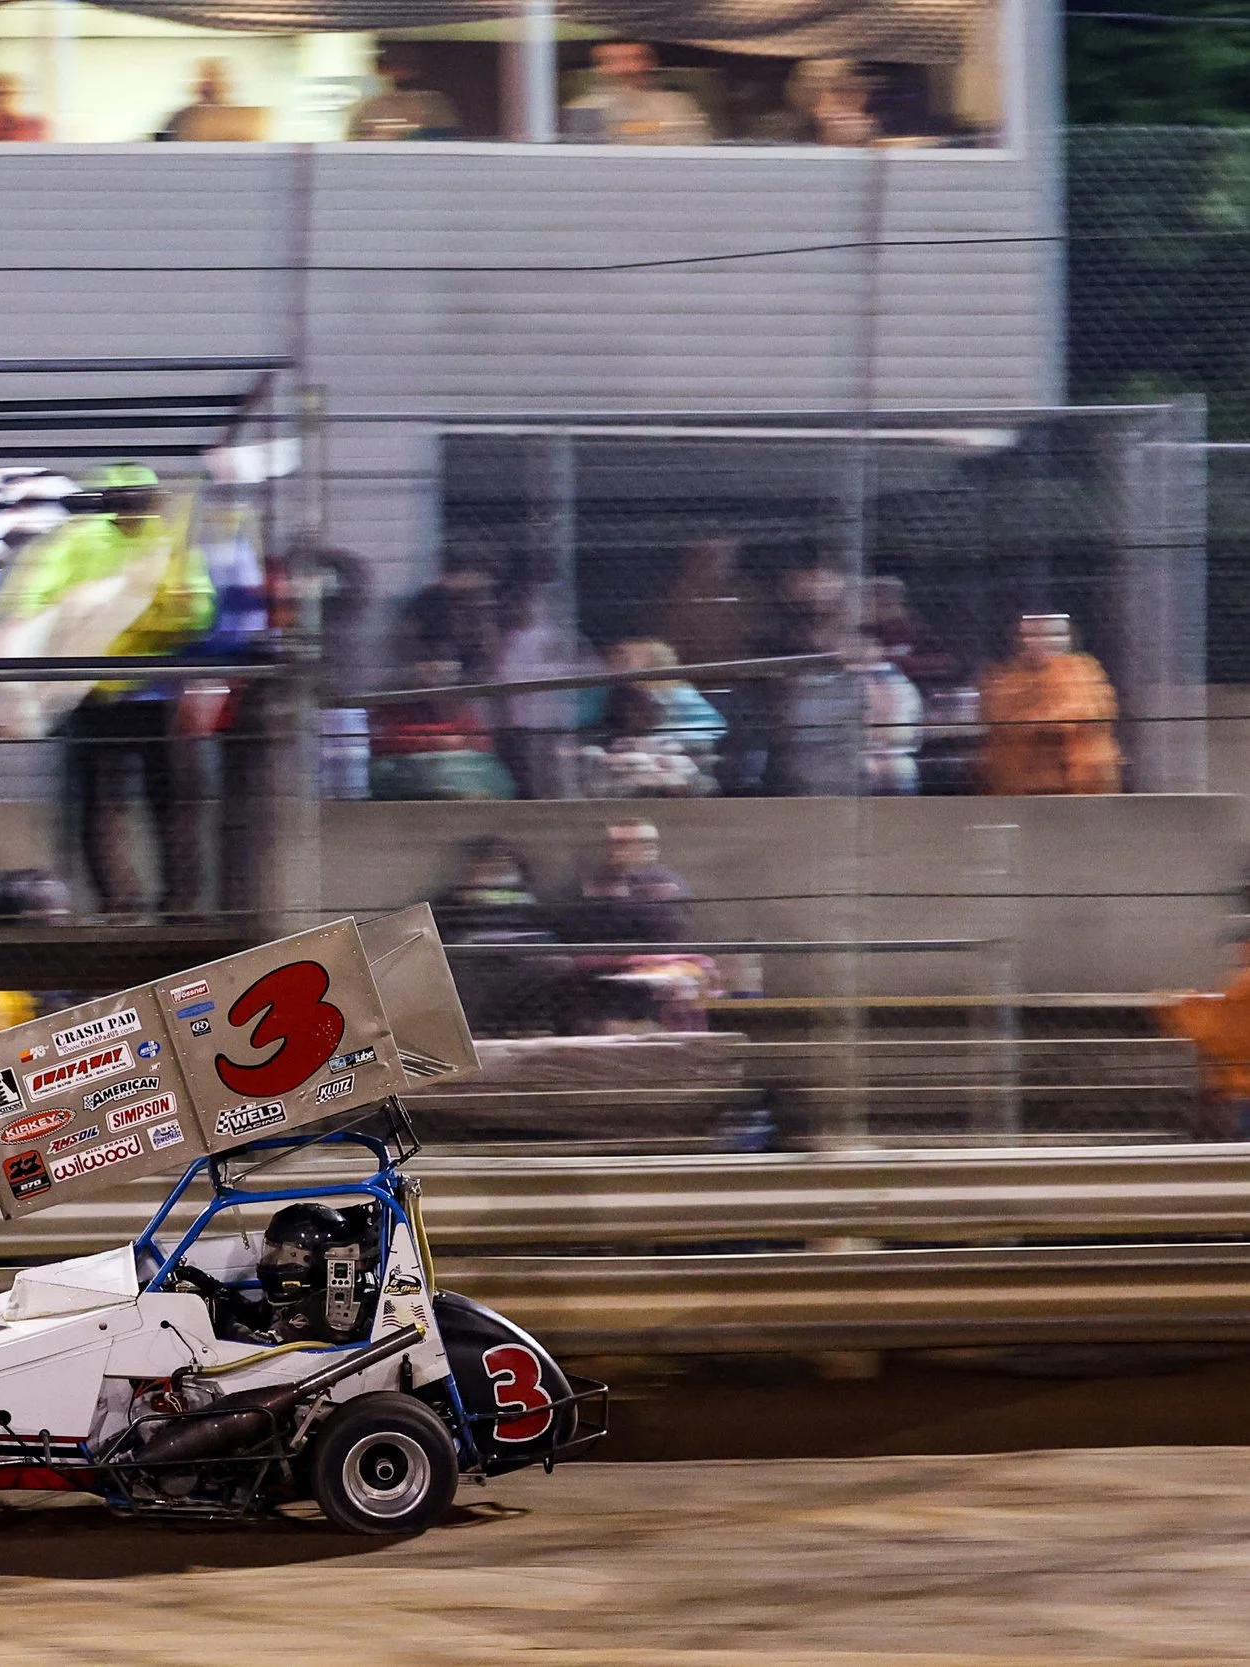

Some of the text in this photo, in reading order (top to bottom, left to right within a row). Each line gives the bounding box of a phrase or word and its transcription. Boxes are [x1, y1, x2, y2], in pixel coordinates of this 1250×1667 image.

[55, 1012, 136, 1046] CRASH PAD
[215, 960, 345, 1097] 3
[33, 1047, 123, 1091] SWAY-A-WAY
[93, 1078, 157, 1107] AMERICAN
[320, 1079, 350, 1099] KLOTZ
[5, 1114, 56, 1137] KIRKEY
[113, 1097, 170, 1128] SIMPSON
[230, 1104, 282, 1128] WELD
[235, 1115, 283, 1134] RACING
[50, 1127, 98, 1152] AMSOIL
[104, 1137, 132, 1149] BRAKES
[54, 1134, 140, 1180] wilwood
[482, 1343, 553, 1442] 3
